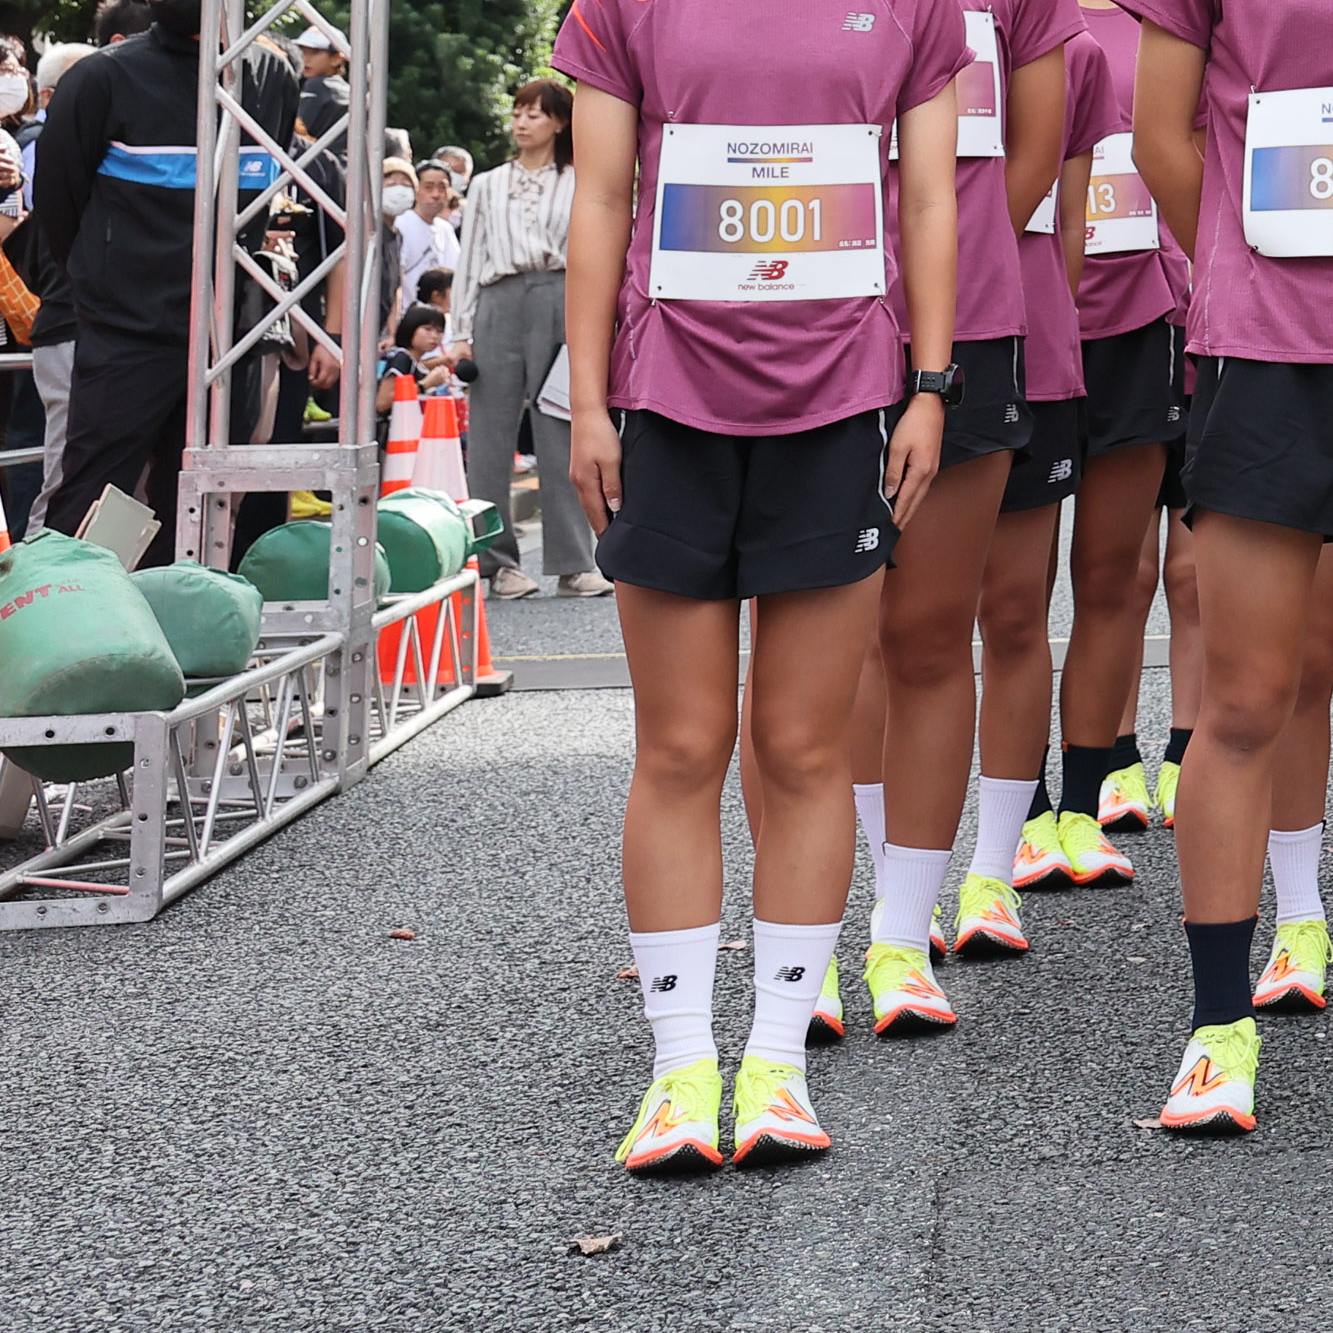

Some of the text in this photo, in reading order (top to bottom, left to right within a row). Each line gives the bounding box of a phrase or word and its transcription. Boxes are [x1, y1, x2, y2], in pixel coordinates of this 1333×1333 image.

[727, 141, 814, 155] NOZOMIRAI
[751, 166, 790, 179] MILE
[718, 198, 822, 243] 8001
[738, 283, 795, 292] new balance
